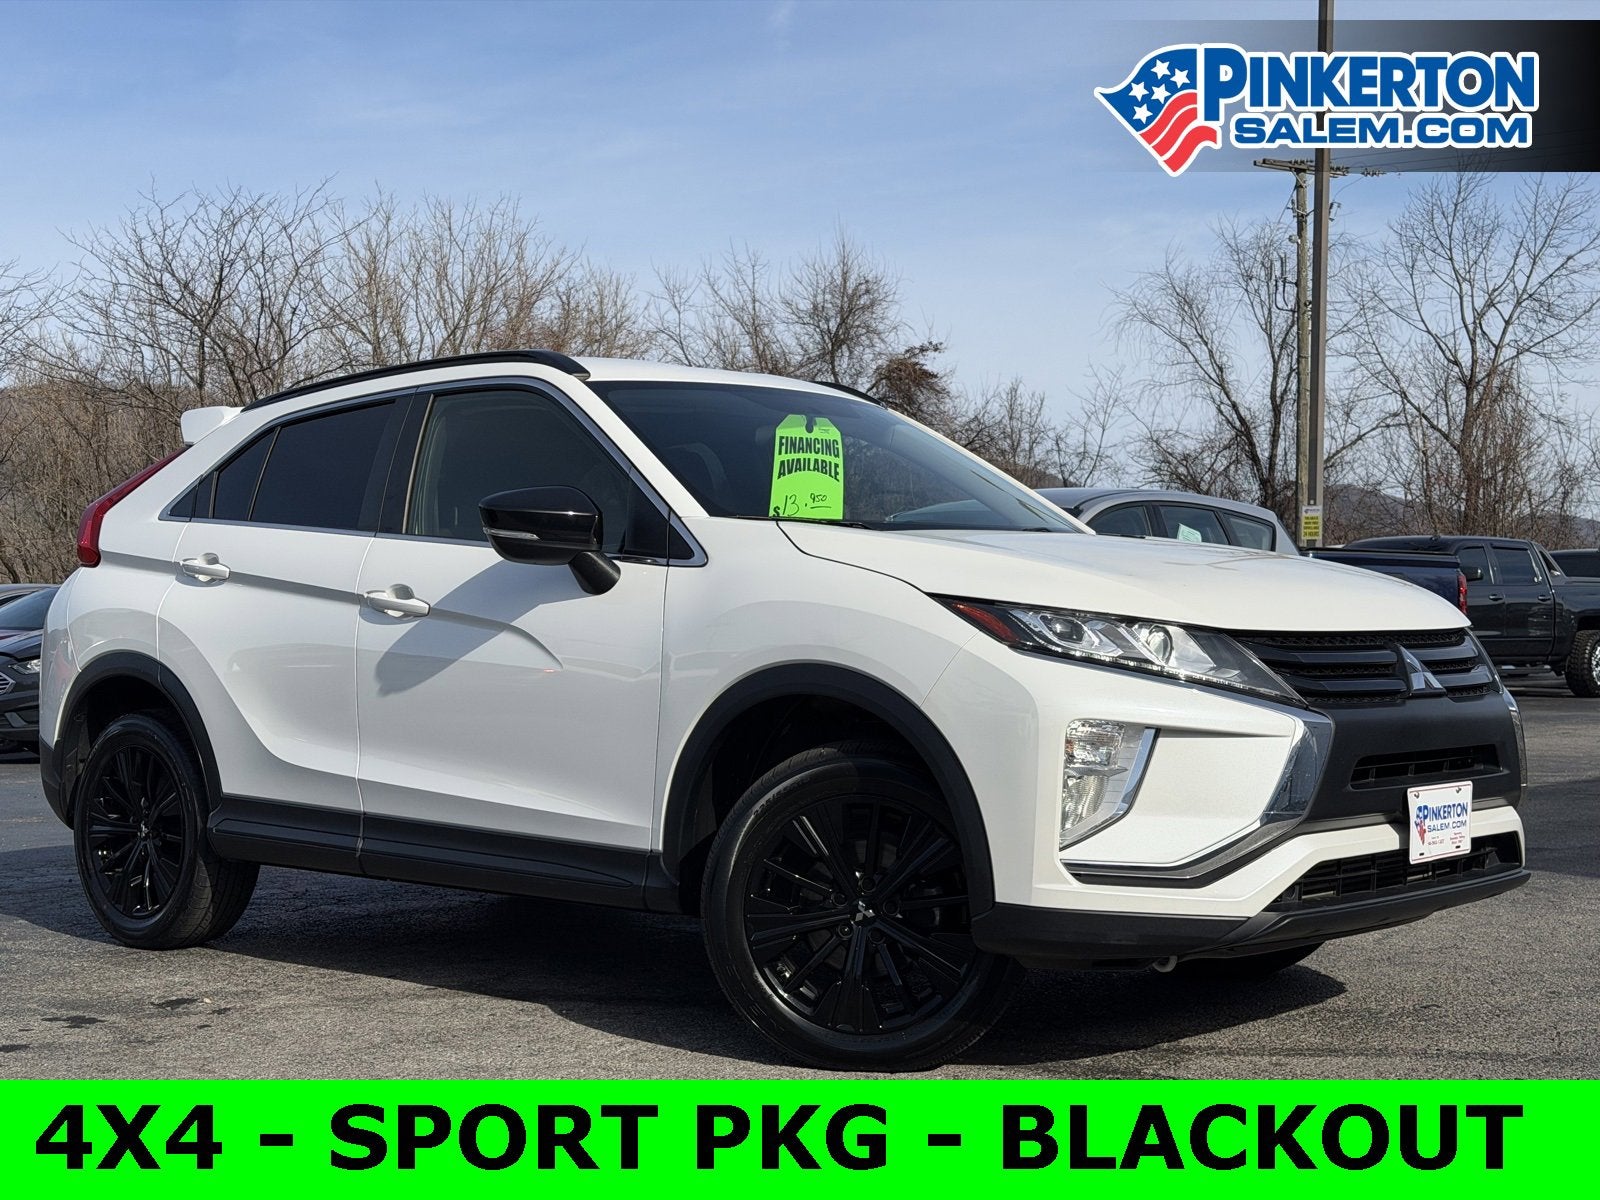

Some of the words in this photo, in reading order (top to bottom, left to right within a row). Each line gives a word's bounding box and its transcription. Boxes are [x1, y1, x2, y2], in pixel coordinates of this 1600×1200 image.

[778, 435, 840, 458] FINANCING
[777, 458, 840, 482] AVAILABLE
[1423, 802, 1469, 823] PINKERTON
[1427, 819, 1467, 833] SALEM.COM
